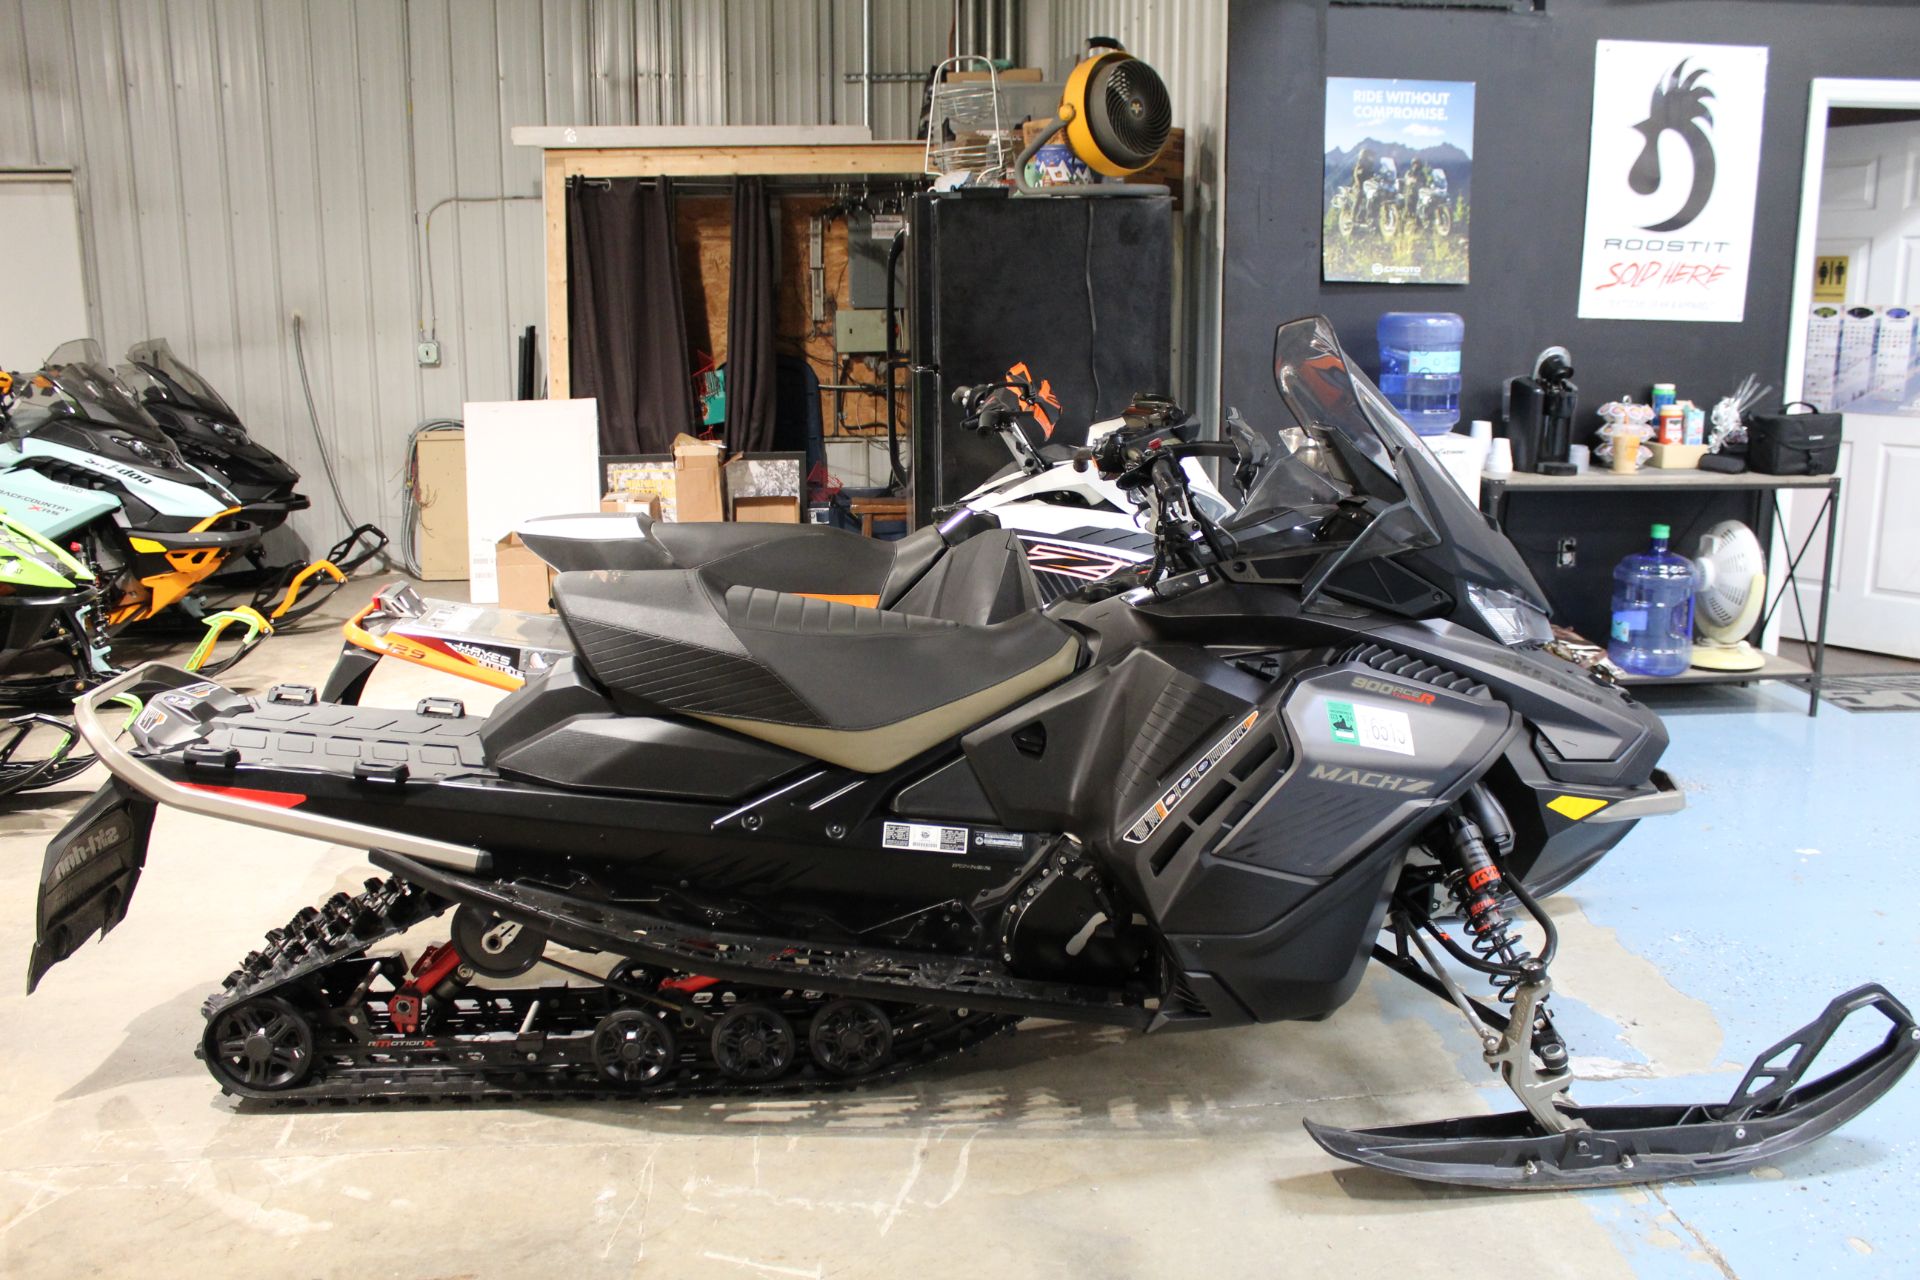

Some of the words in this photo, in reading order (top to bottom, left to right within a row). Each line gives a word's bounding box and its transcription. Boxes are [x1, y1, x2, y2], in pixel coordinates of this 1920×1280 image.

[1353, 89, 1384, 103] RIDE
[1386, 90, 1450, 105] WITHOUT
[1353, 105, 1448, 120] COMPROMISE.
[1604, 238, 1731, 253] ROOSTIT
[1594, 260, 1662, 290] SOLD
[1658, 261, 1732, 290] HERE
[452, 641, 512, 666] HAYES
[1351, 674, 1394, 695] 900
